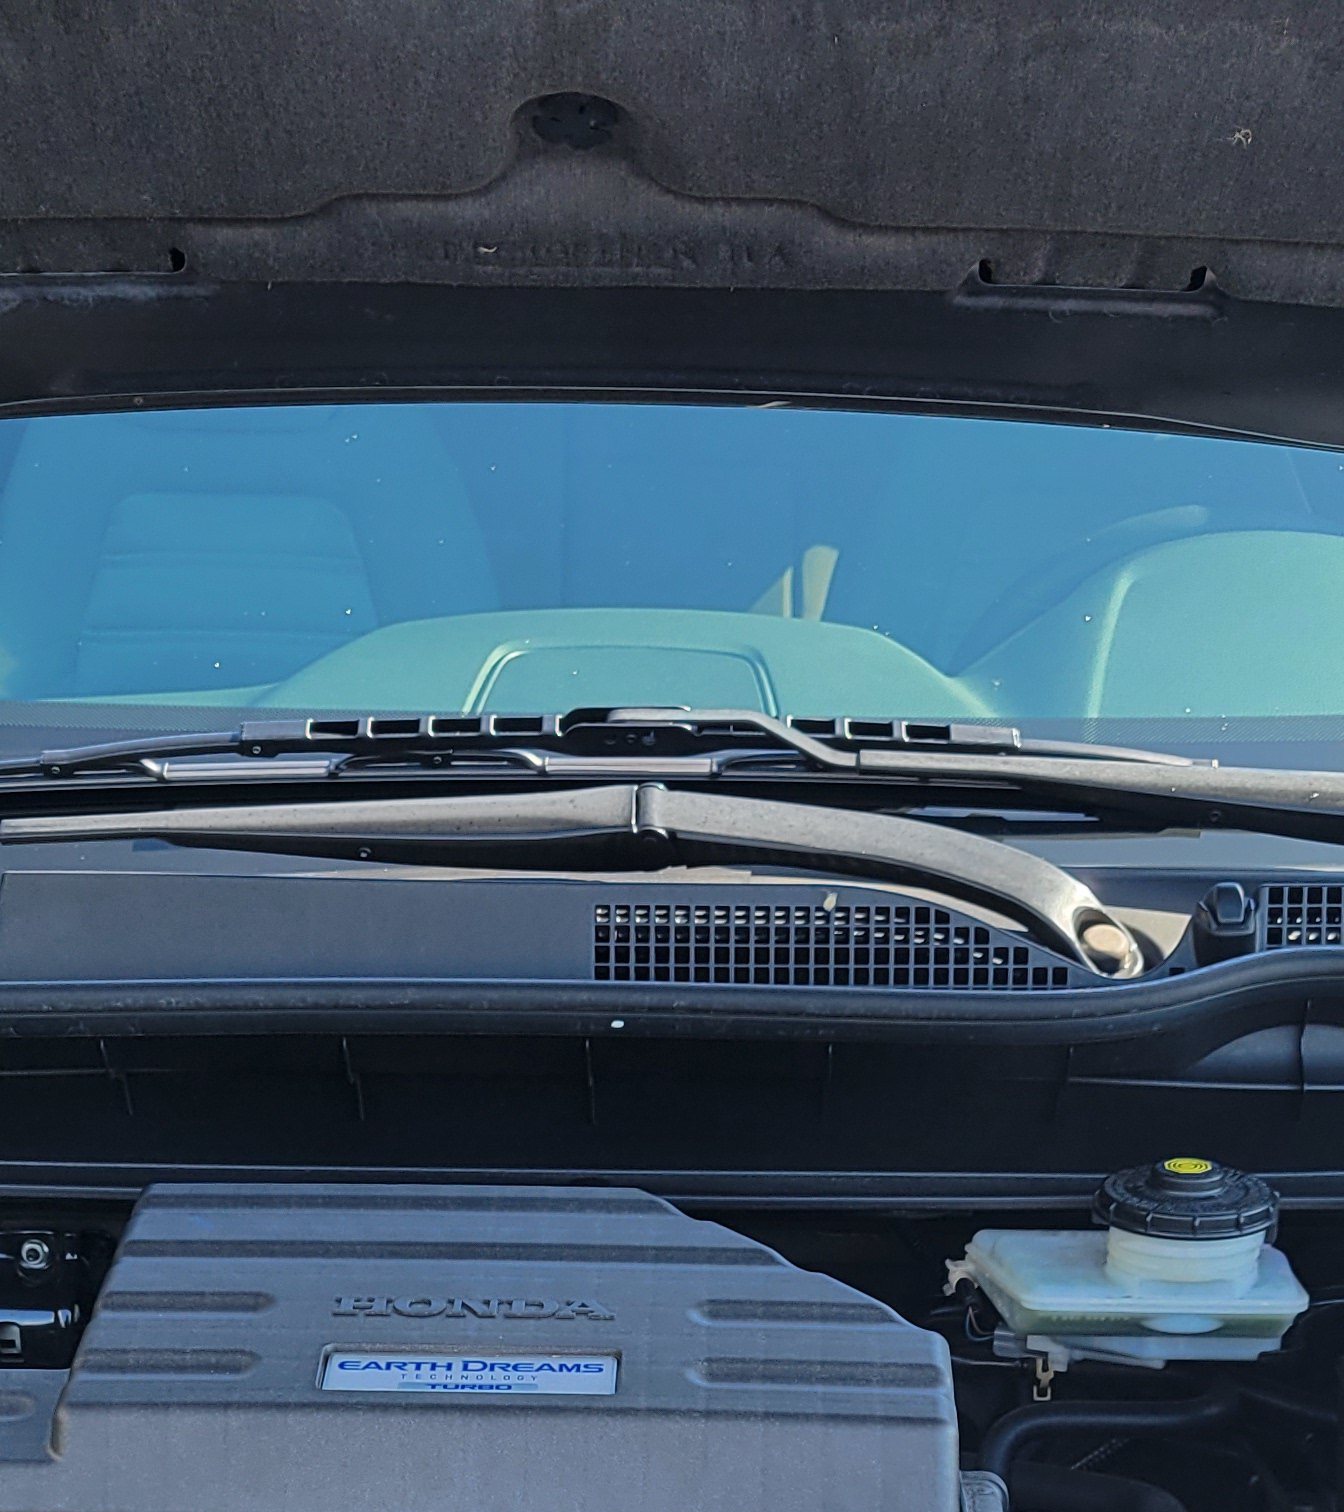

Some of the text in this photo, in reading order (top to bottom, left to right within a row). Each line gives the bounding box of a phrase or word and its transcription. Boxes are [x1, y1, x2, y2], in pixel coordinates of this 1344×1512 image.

[331, 1296, 617, 1321] HONDA
[337, 1360, 453, 1373] EARTH
[401, 1373, 538, 1382] TECHNOLOGY
[425, 1383, 512, 1391] TURBO
